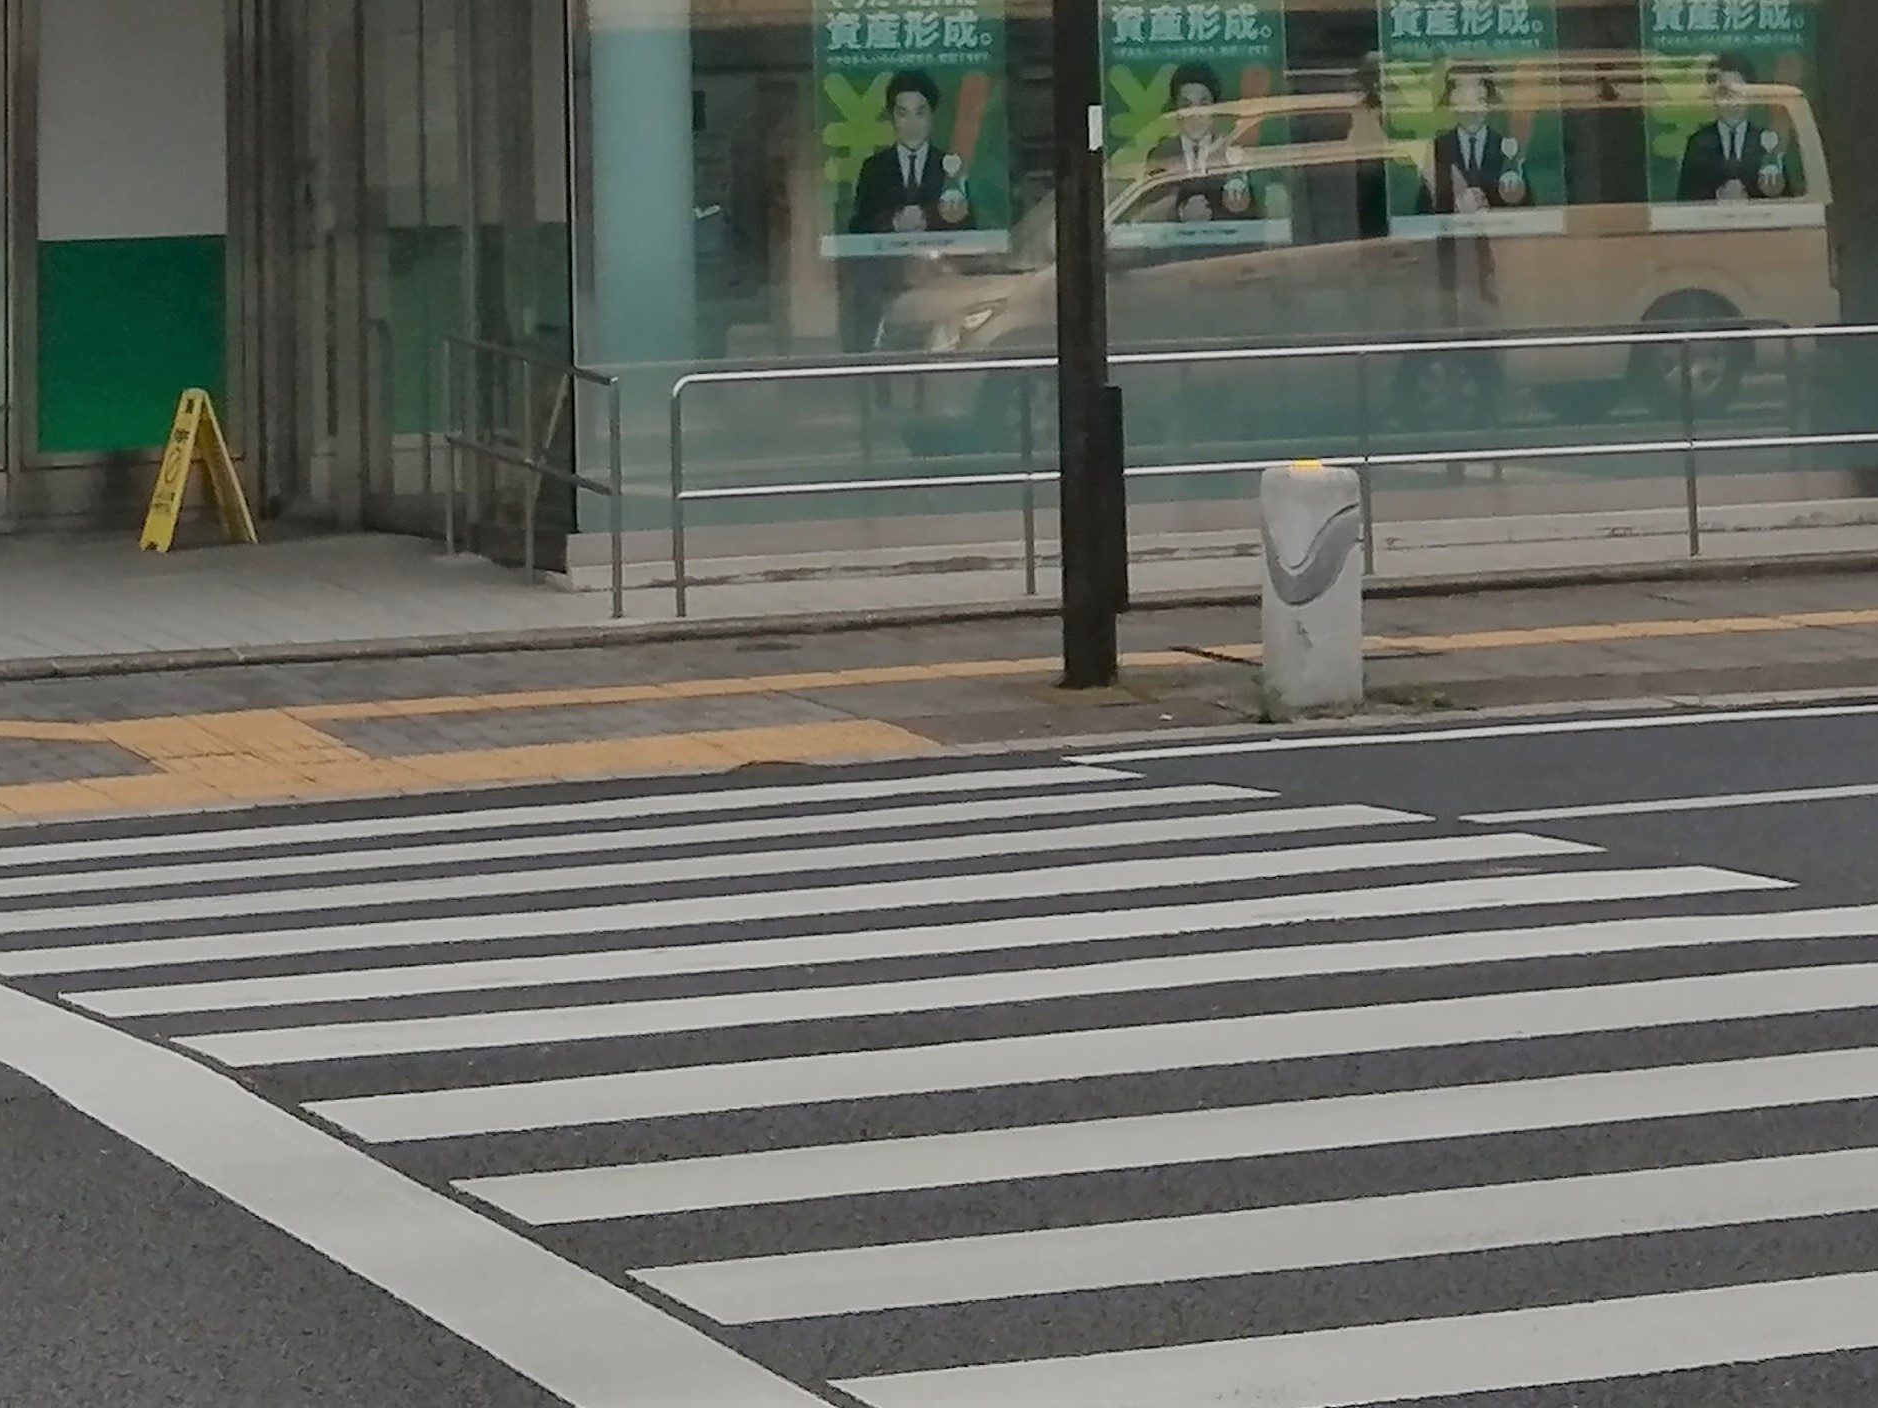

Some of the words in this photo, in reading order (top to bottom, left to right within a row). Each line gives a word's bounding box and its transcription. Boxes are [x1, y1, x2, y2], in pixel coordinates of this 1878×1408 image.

[824, 9, 995, 52] 資産形成。
[1110, 3, 1273, 44] 資産形成。
